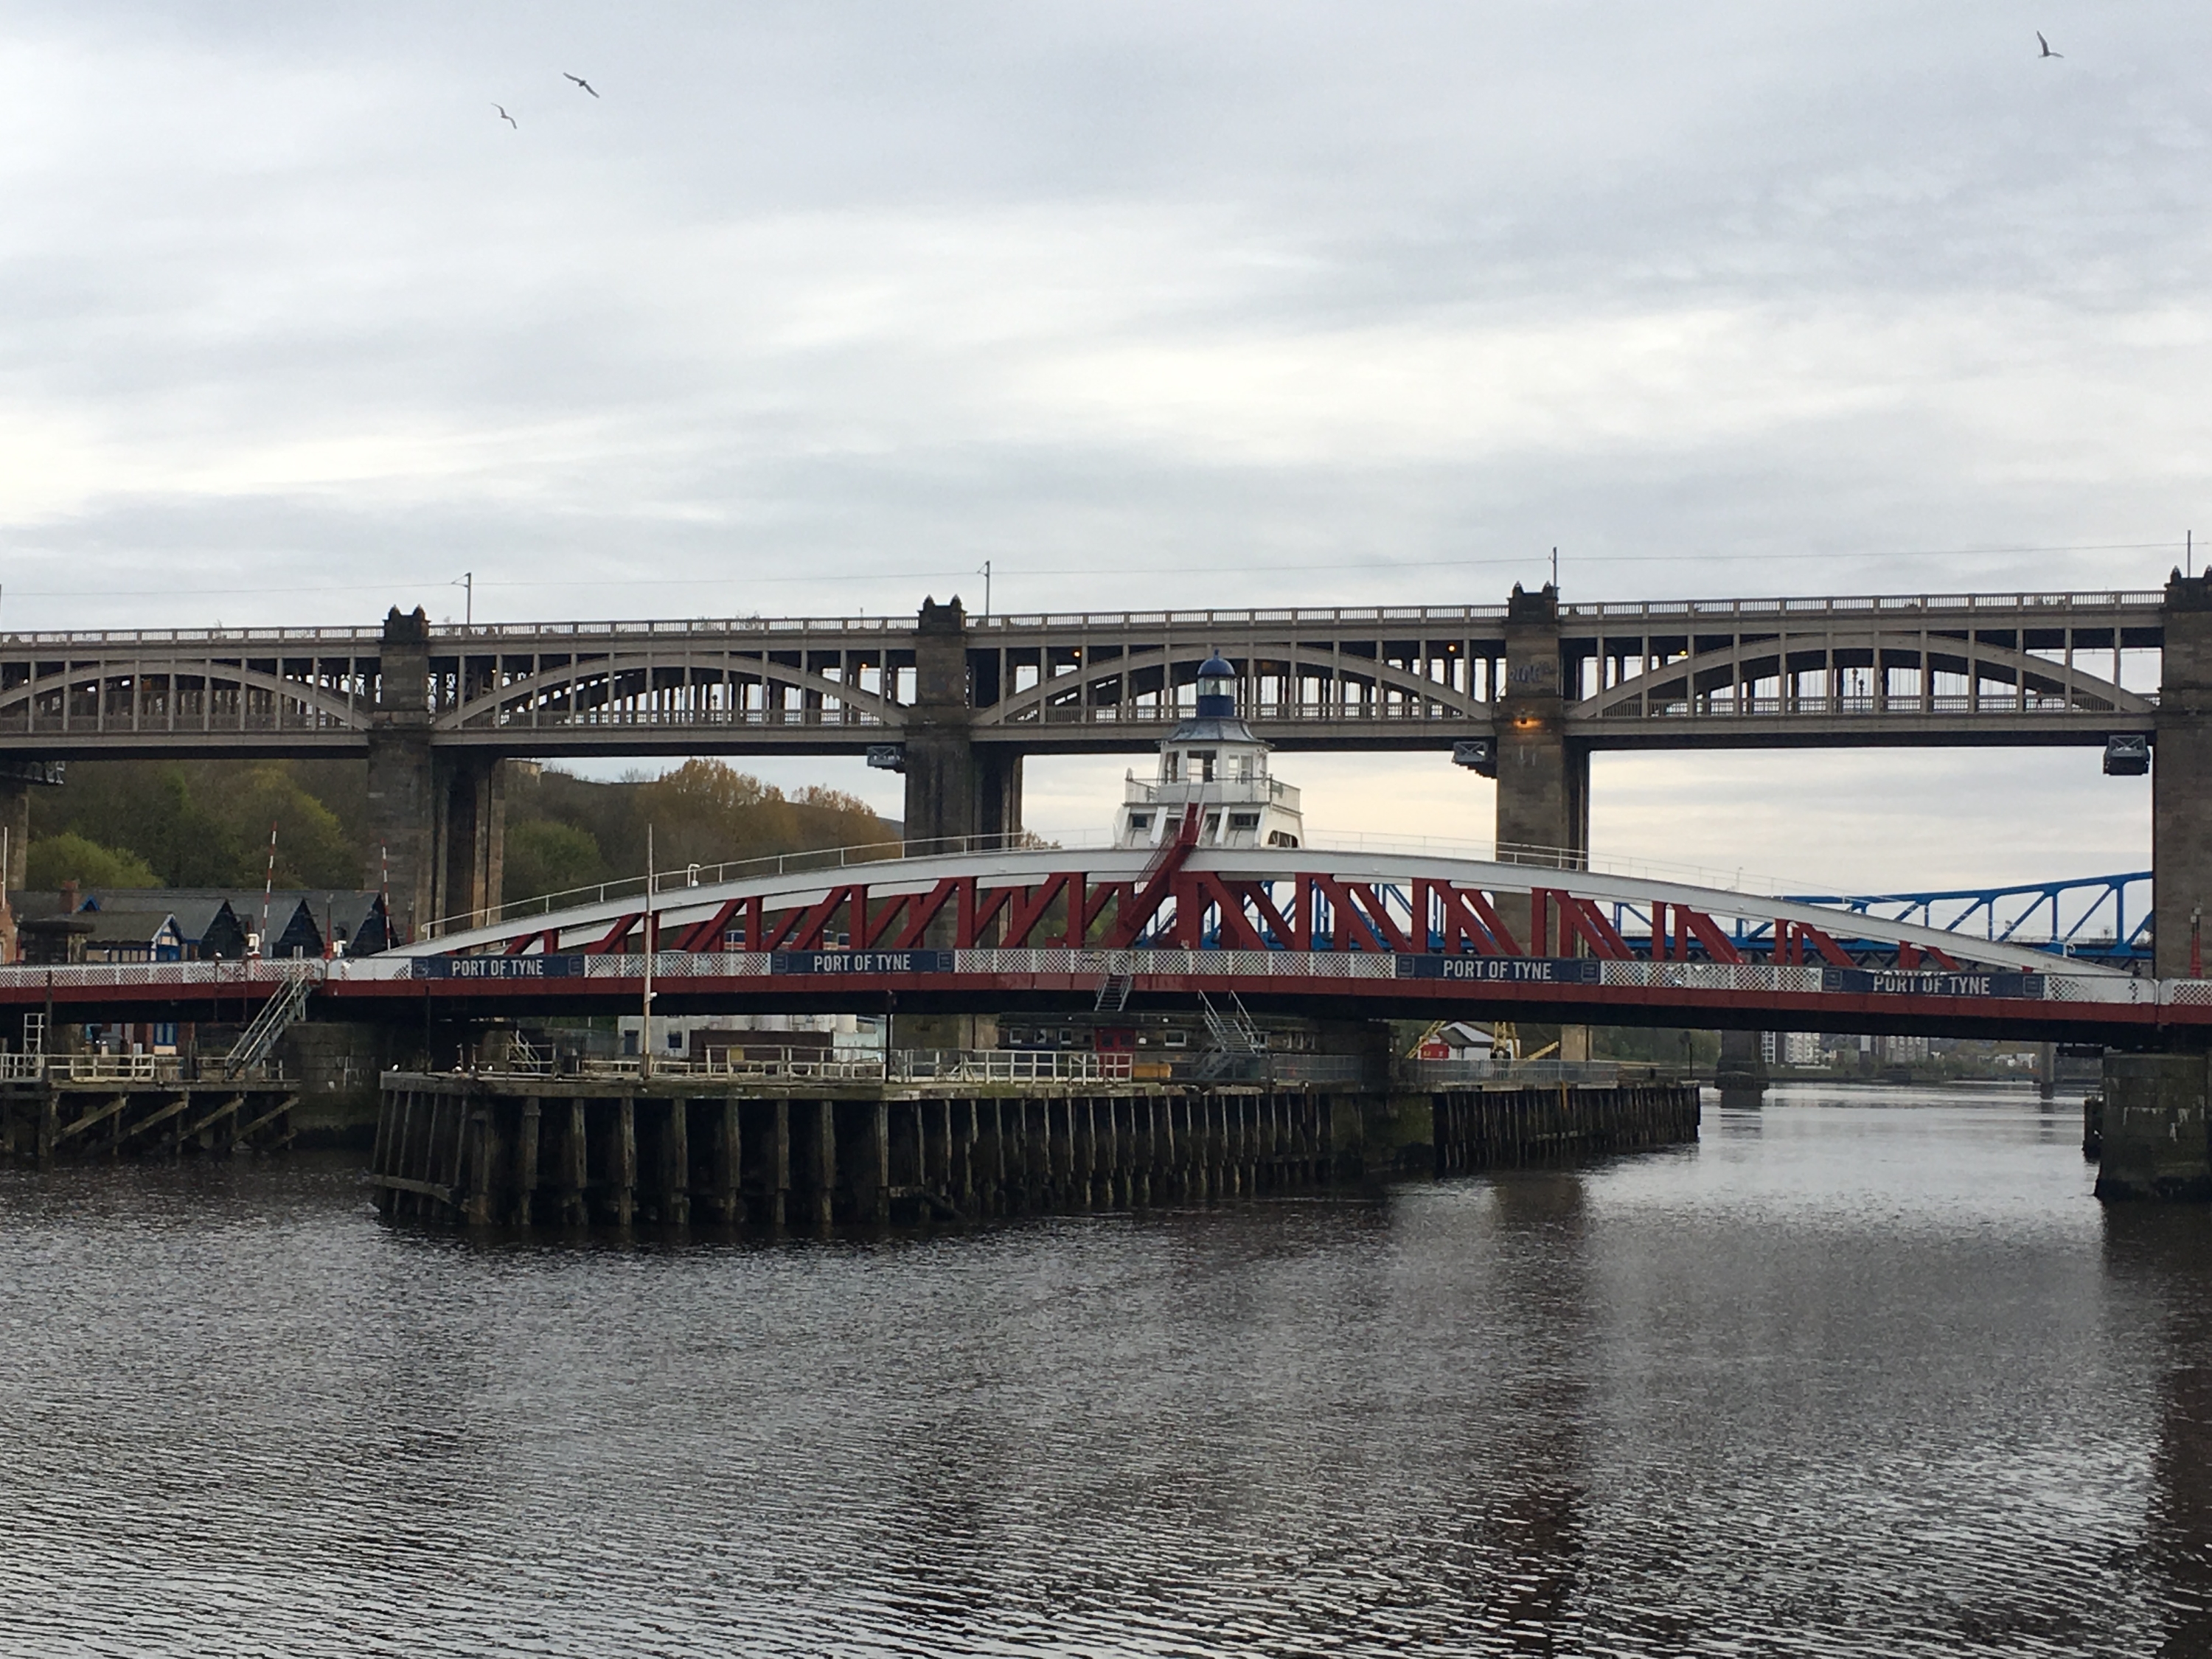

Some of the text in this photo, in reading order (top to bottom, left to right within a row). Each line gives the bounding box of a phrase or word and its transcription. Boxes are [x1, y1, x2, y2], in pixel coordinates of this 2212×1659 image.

[452, 959, 543, 976] PORT OF TYNE
[814, 954, 911, 972] PORT OF TYNE
[1443, 960, 1552, 980] PORT OF TYNE
[1873, 975, 1991, 995] PORT OF TYNE
